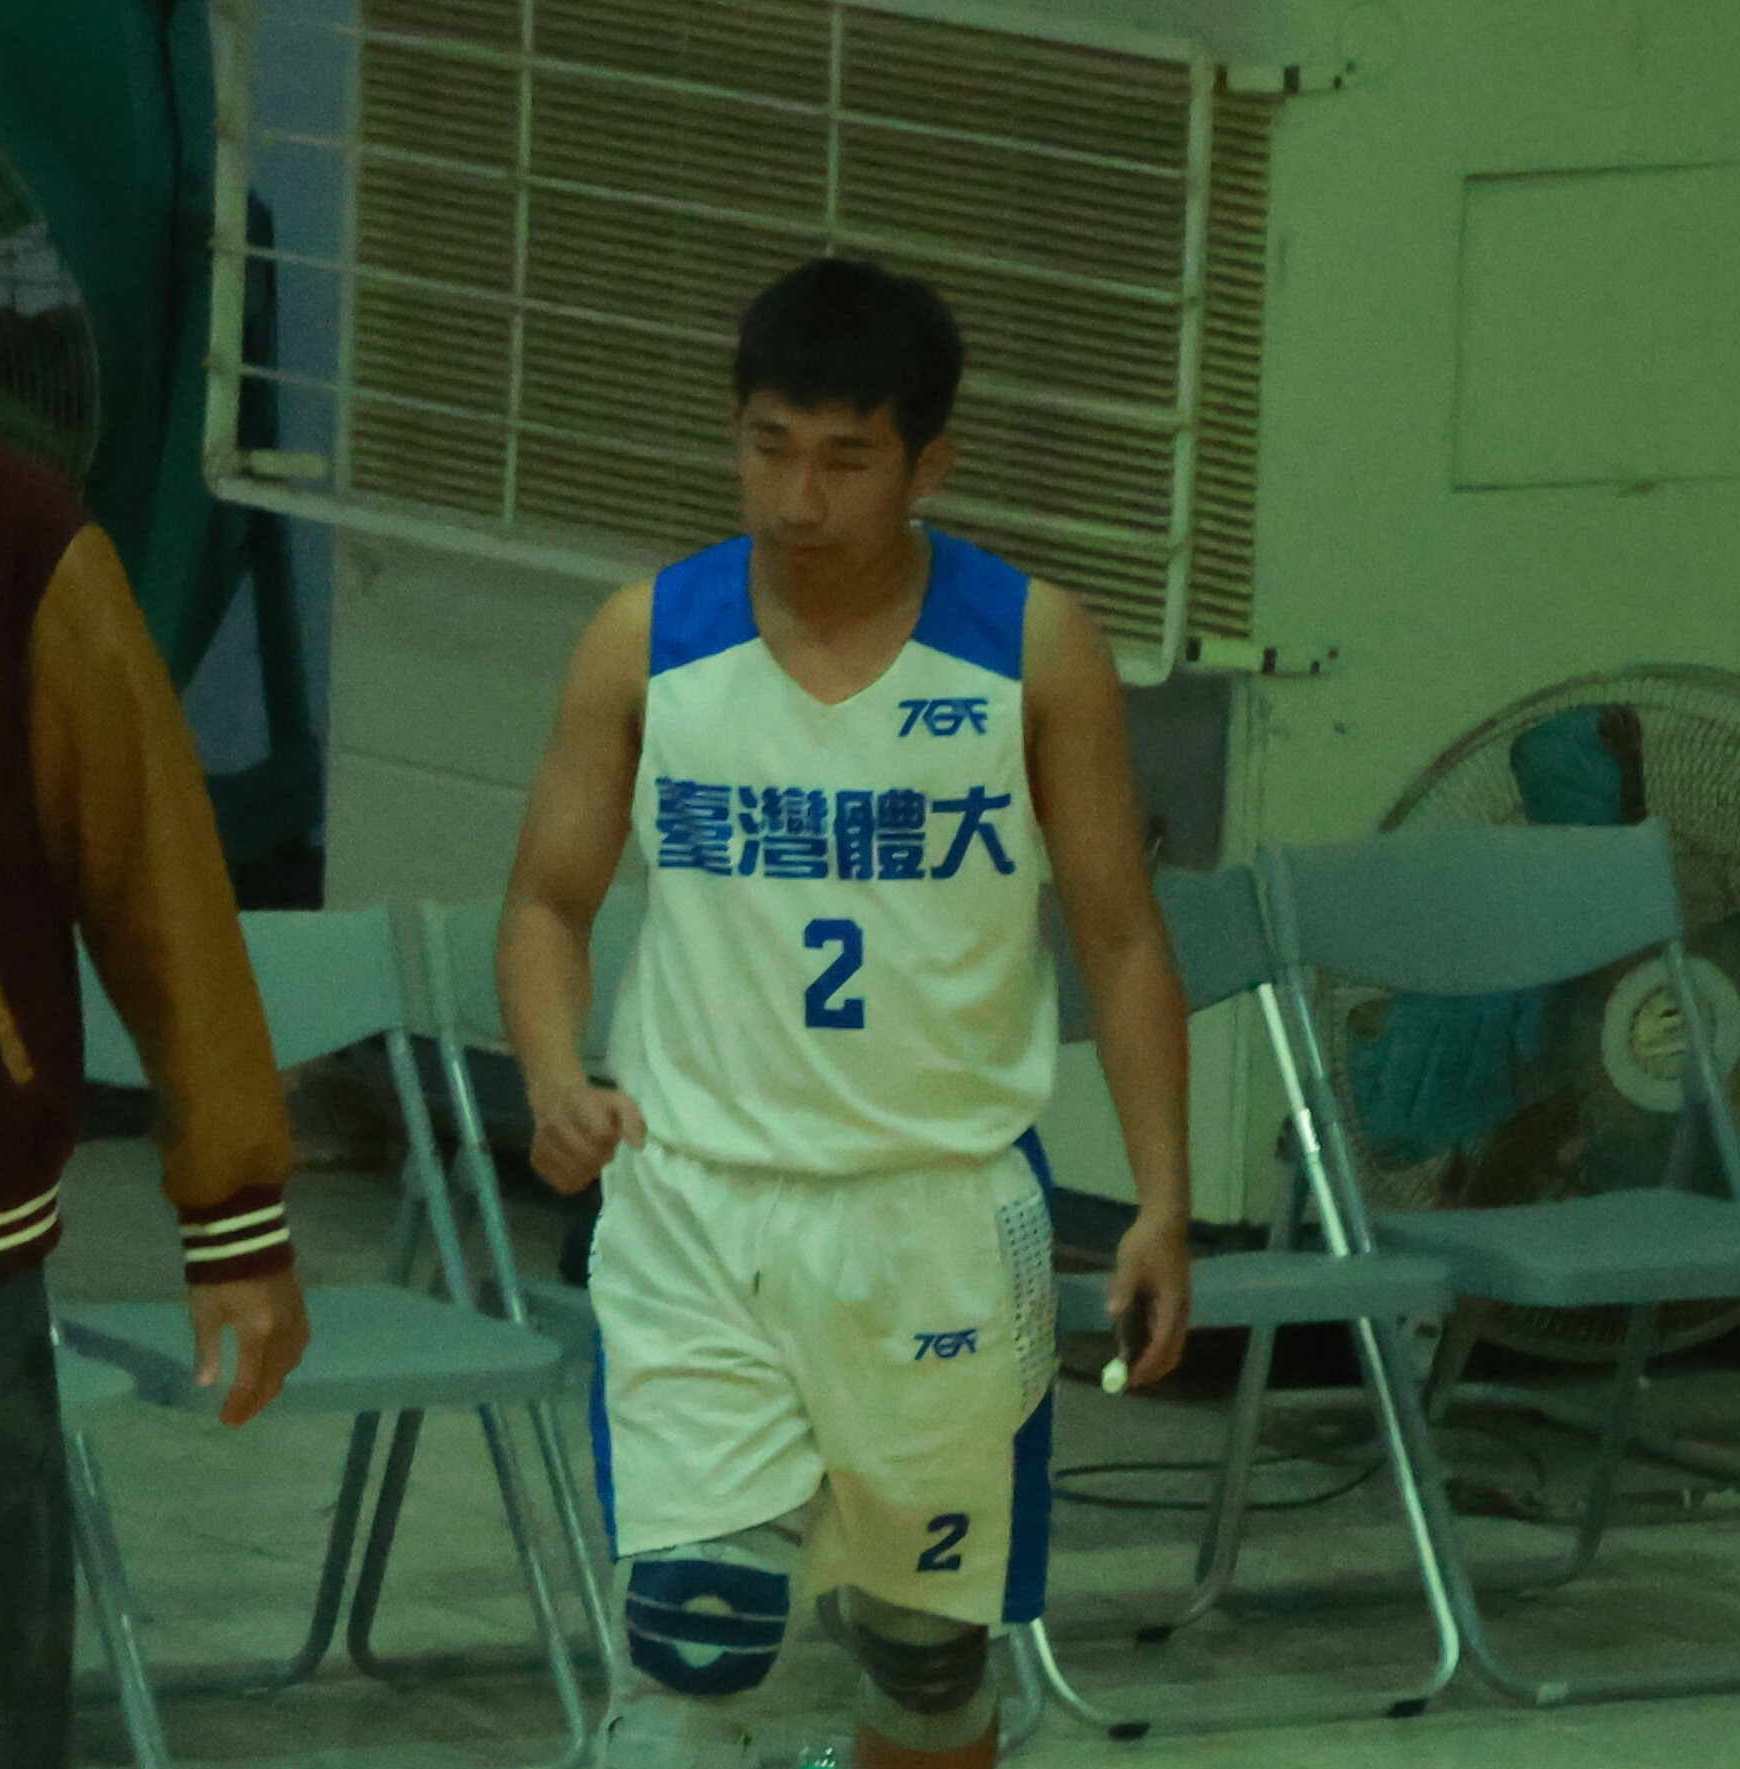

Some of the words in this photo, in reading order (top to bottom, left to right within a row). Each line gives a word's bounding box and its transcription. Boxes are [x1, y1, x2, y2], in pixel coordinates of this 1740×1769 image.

[655, 777, 1016, 882] 臺灣體大
[803, 918, 865, 1030] 2
[916, 1512, 970, 1573] 2
